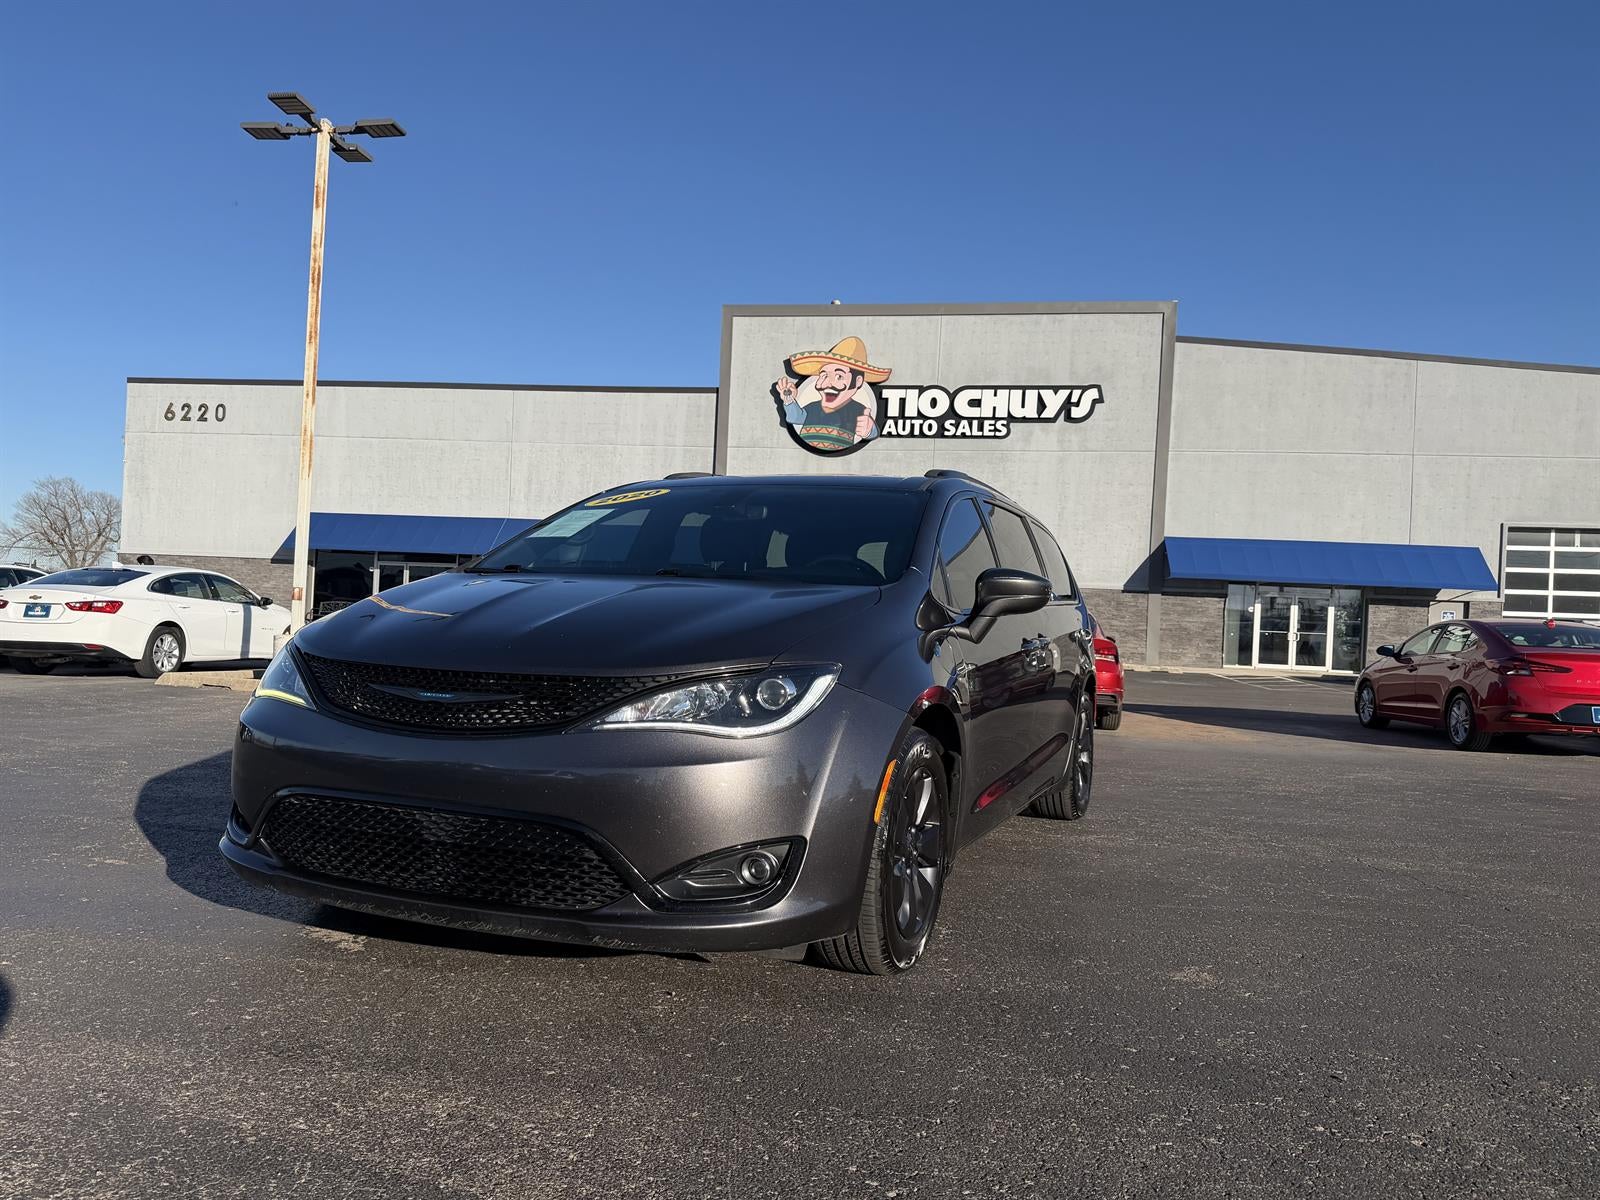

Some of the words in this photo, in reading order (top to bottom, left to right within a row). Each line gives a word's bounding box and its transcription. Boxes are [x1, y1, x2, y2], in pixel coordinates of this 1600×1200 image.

[164, 402, 226, 422] 6220
[882, 389, 950, 418] TIO
[953, 388, 1100, 418] CHUY'S
[882, 419, 938, 436] AUTO
[943, 419, 1008, 437] SALES
